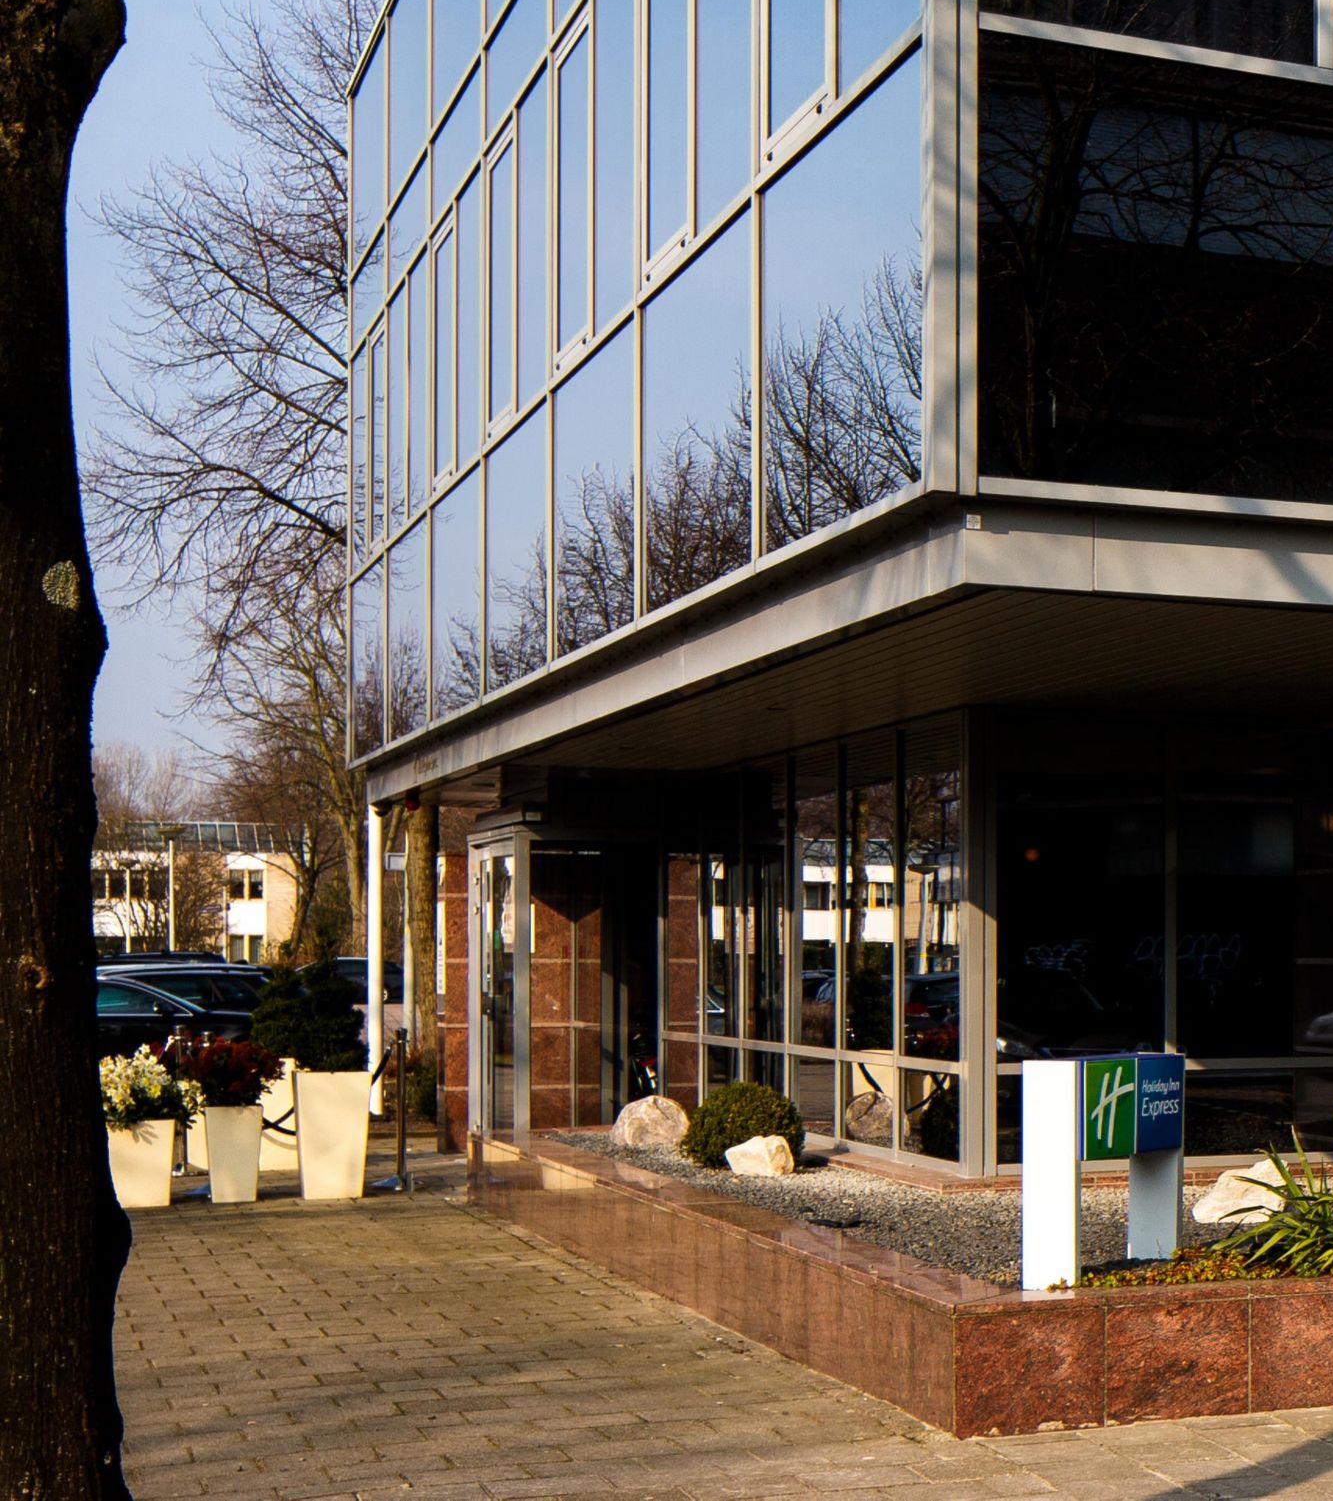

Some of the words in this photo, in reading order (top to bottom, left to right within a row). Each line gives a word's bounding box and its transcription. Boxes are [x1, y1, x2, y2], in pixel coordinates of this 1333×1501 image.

[1141, 1079, 1168, 1095] Holiday
[1168, 1078, 1180, 1092] Inn
[1141, 1097, 1179, 1120] Express
